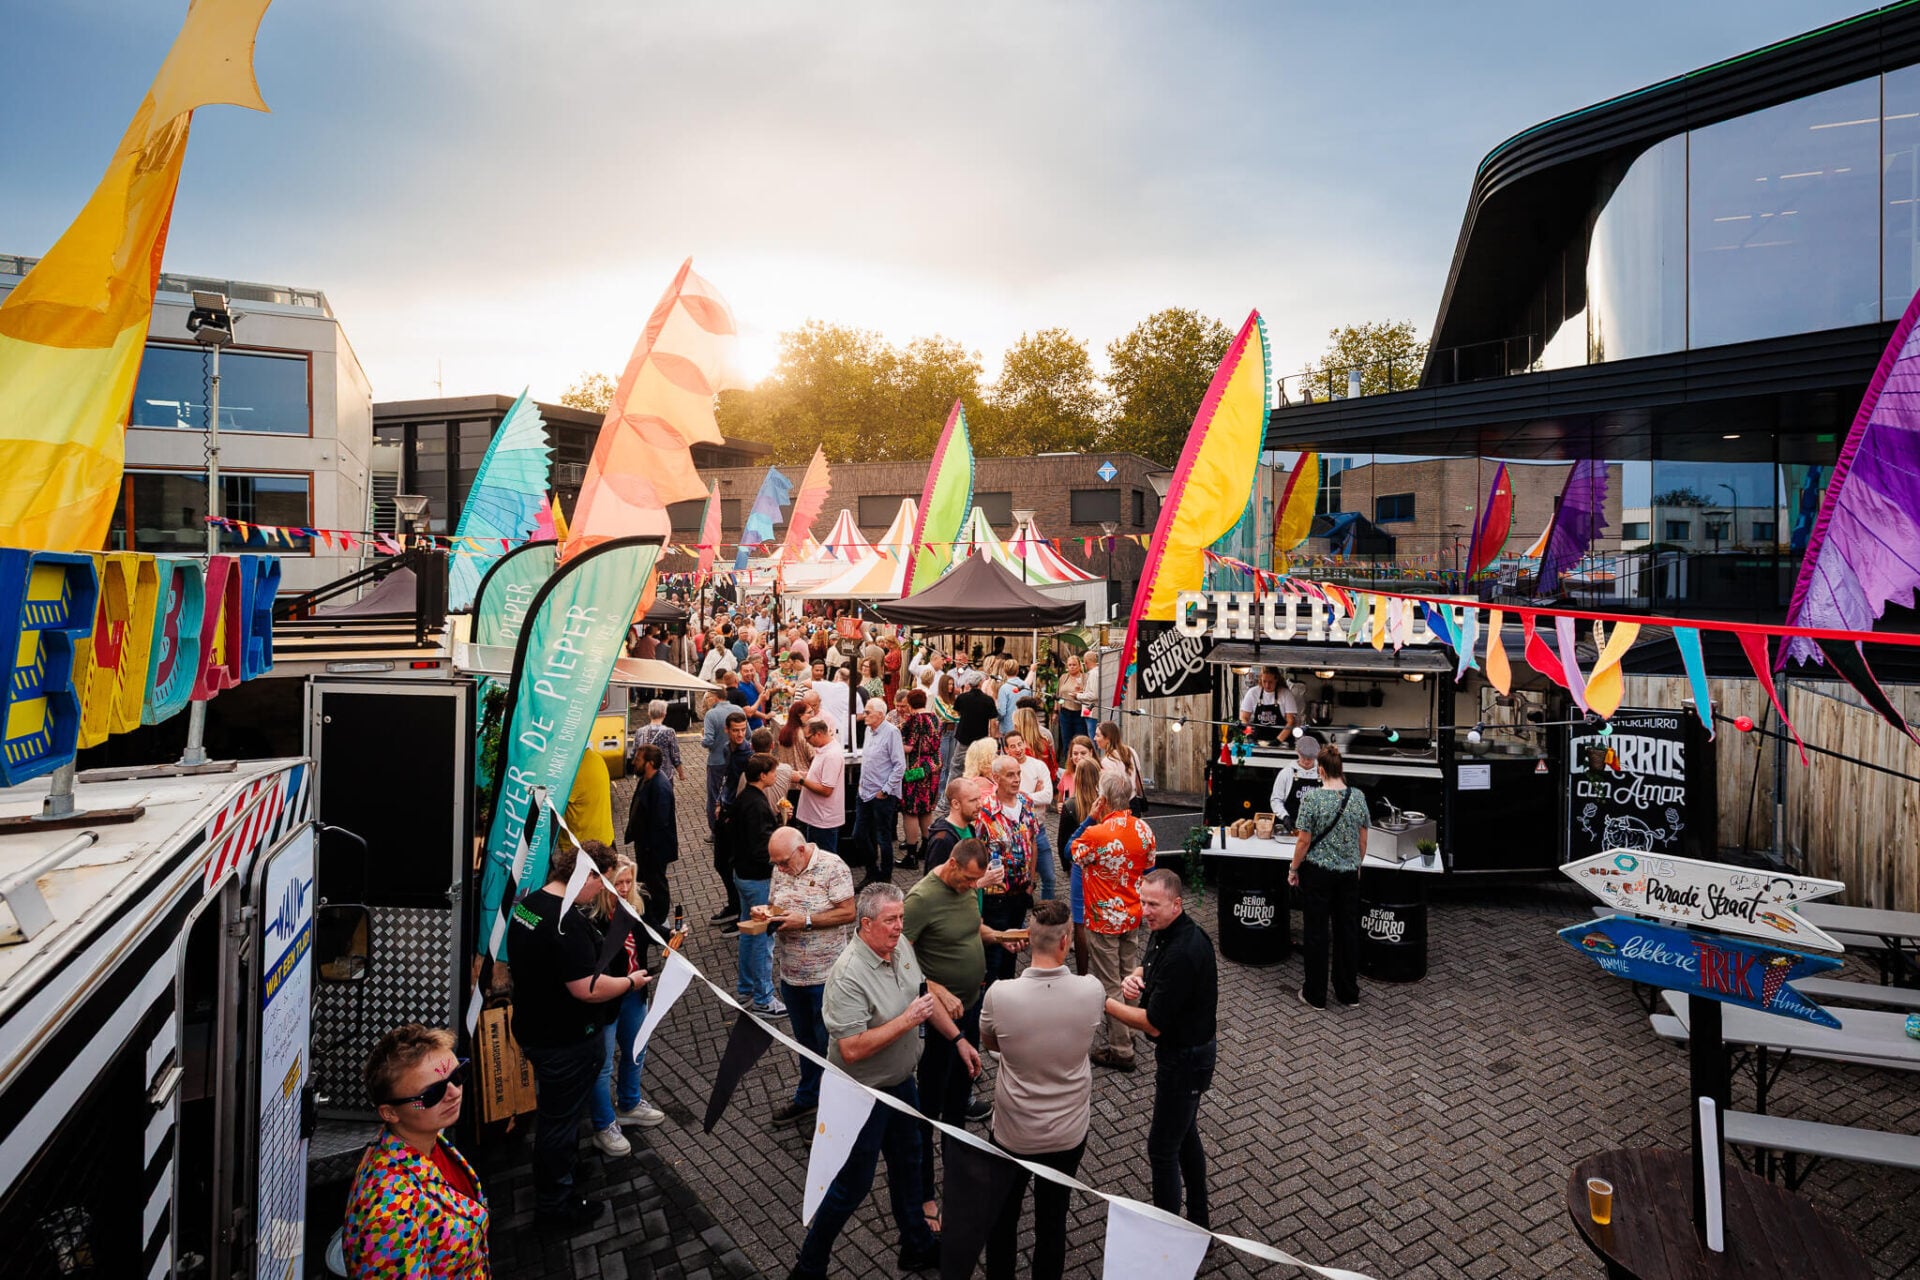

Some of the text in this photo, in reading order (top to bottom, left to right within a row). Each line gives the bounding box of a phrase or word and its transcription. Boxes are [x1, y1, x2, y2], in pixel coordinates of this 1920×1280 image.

[499, 583, 532, 640] PIEPER
[533, 604, 599, 702] PIEPER
[1142, 637, 1205, 695] CHURRO
[519, 716, 554, 753] DE
[276, 877, 304, 941] WAUW
[1233, 904, 1275, 927] CHURRO
[1242, 895, 1266, 906] SEÑOR
[1370, 908, 1395, 921] SEÑOR
[1646, 878, 1700, 908] Parade
[1701, 884, 1768, 924] Straat
[1361, 916, 1405, 943] CHURRO
[265, 964, 283, 999] WAT
[283, 950, 295, 977] EEN
[1597, 955, 1630, 973] YAMMIE
[1620, 935, 1756, 1000] lekkere TREK
